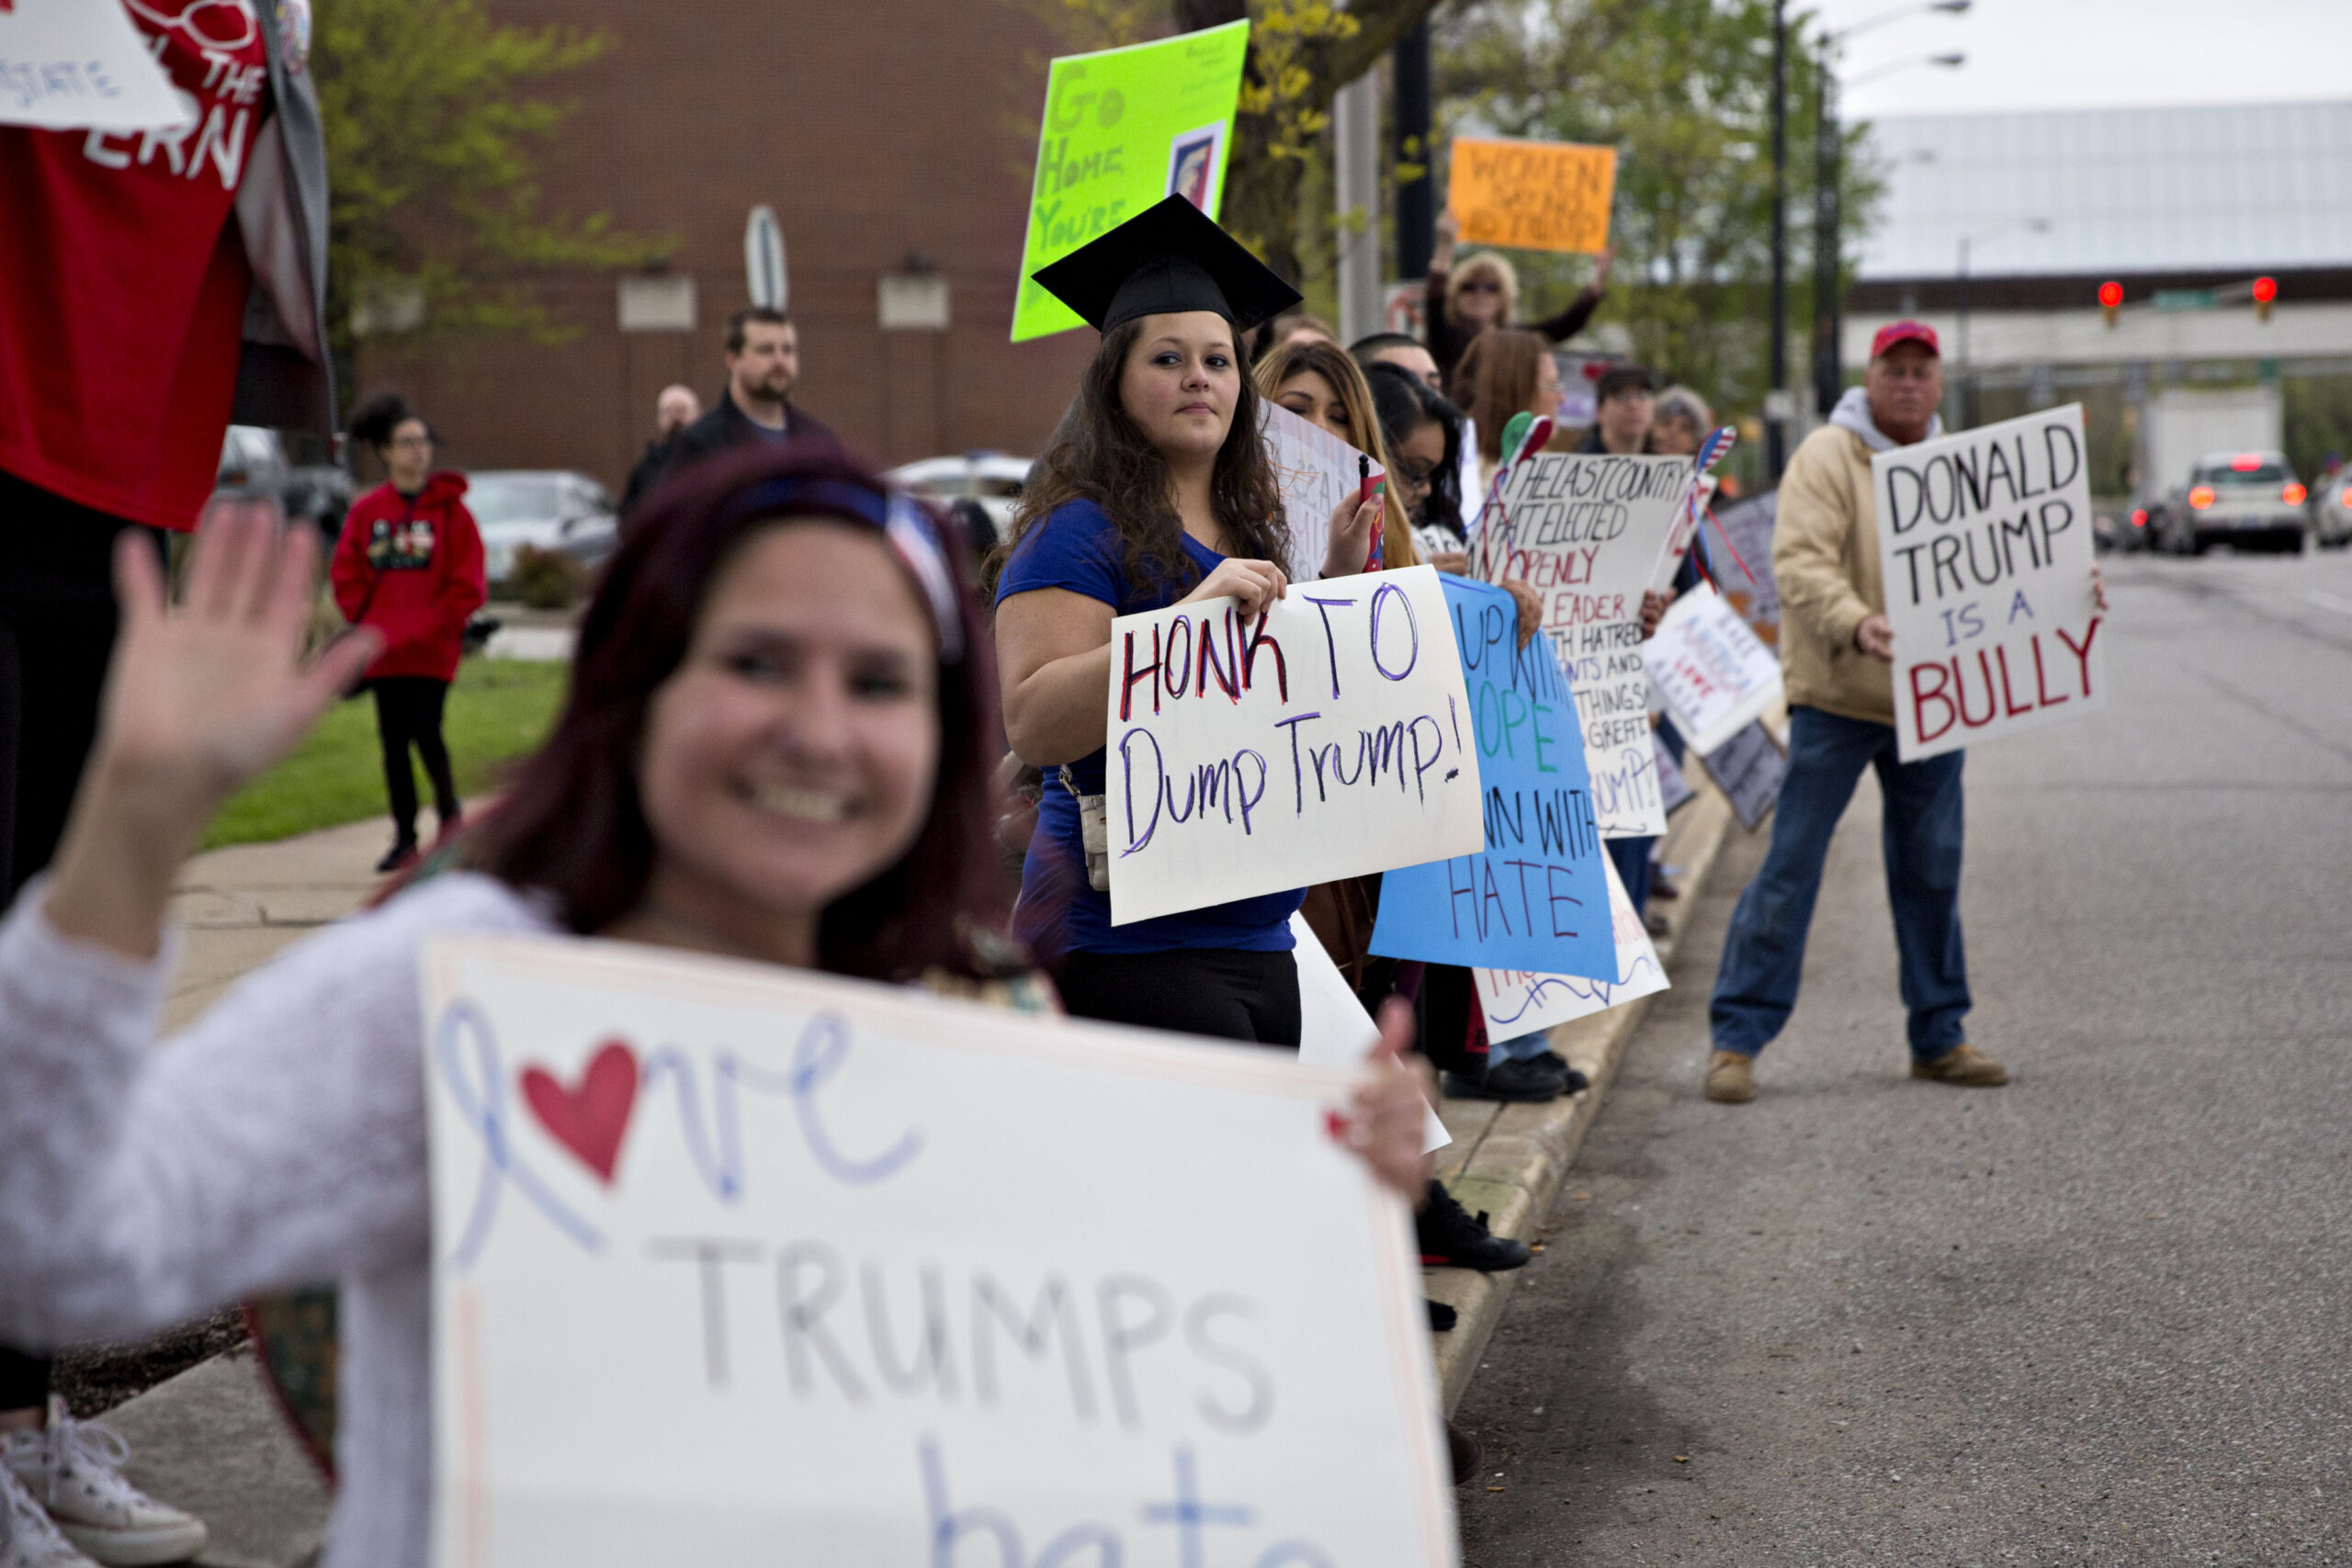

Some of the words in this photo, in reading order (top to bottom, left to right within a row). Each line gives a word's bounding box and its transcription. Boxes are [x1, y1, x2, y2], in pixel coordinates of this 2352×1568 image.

[200, 49, 264, 104] THE
[83, 103, 249, 190] ERN
[1470, 145, 1603, 195] WOMEN
[1601, 457, 1693, 504] COUNTRY
[1886, 423, 2080, 536] DONALD
[1535, 503, 1628, 546] ELECTED
[1894, 500, 2074, 606] TRUMP
[1119, 606, 1288, 723] HONK
[1303, 582, 1418, 700] TO
[1457, 604, 1504, 677] UP
[1581, 622, 1645, 653] HATRED
[1939, 603, 1984, 647] IS
[2008, 589, 2034, 626] A
[1573, 682, 1647, 720] THINGS
[1606, 653, 1643, 680] AND
[1909, 616, 2104, 745] BULLY
[1465, 678, 1558, 774] OPE
[1119, 728, 1266, 859] Dump
[1274, 694, 1462, 820] Trump!
[1533, 788, 1602, 861] WITH
[1447, 853, 1583, 943] HATE
[643, 1235, 1279, 1438] TRUMPS
